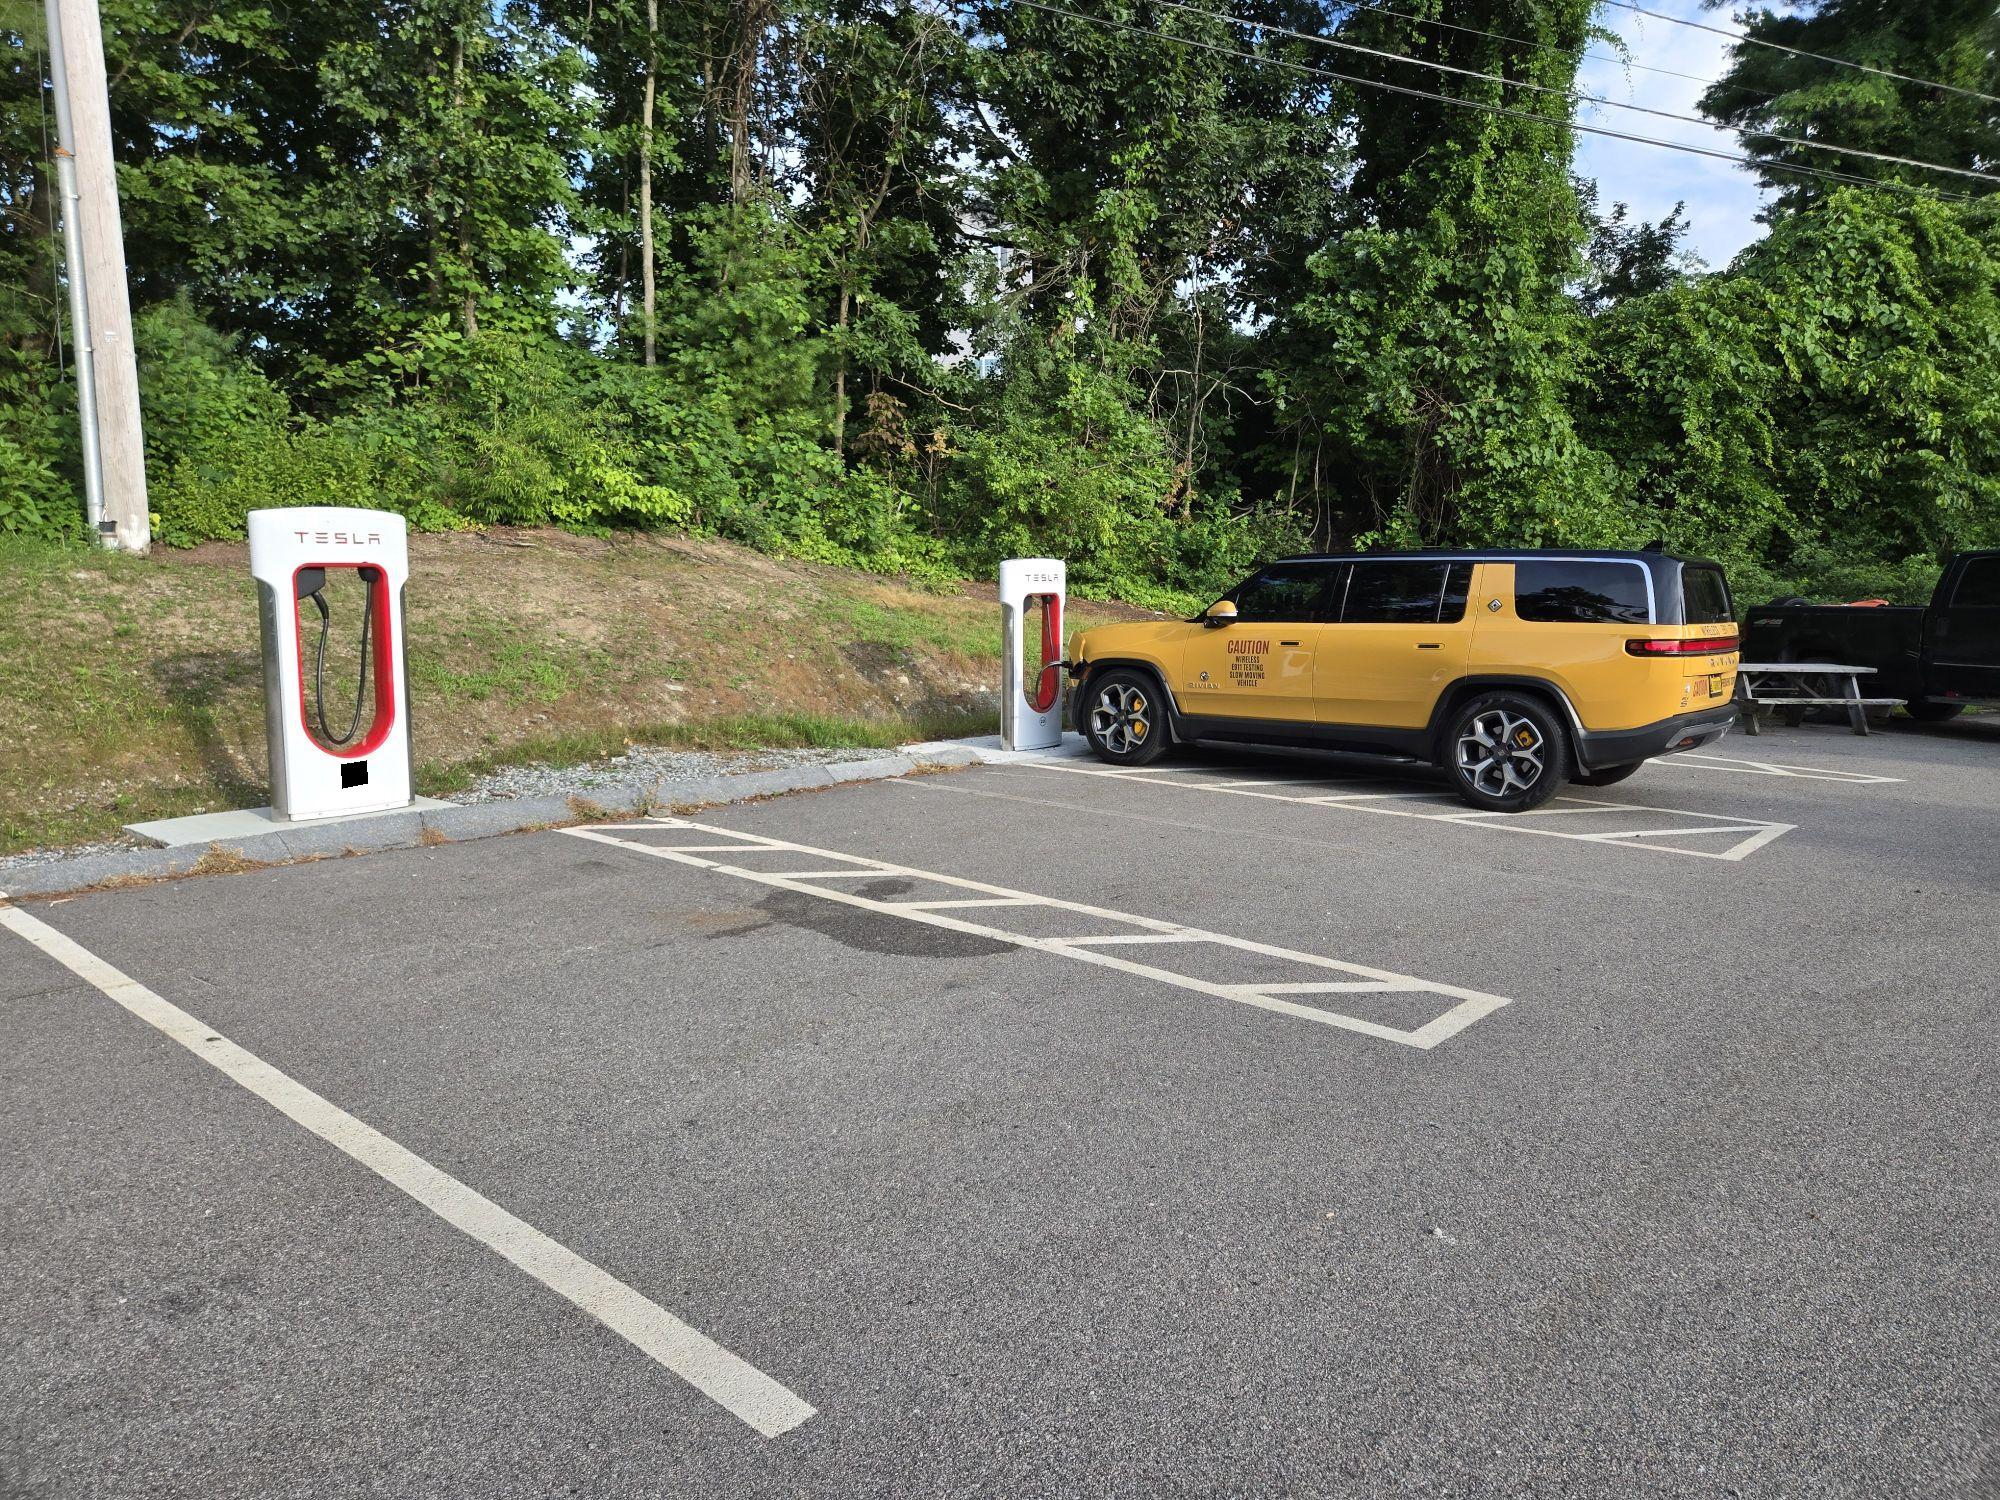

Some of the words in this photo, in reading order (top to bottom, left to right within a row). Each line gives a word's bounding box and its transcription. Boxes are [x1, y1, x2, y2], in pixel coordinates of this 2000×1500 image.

[294, 531, 381, 545] TESLA
[1025, 574, 1059, 582] TESLA
[1227, 639, 1270, 655] CAUTION
[1235, 656, 1260, 664] WIRELESS
[1229, 671, 1244, 679] SLOW
[1244, 671, 1265, 680] MOVING
[1236, 679, 1258, 687] VEHICLE
